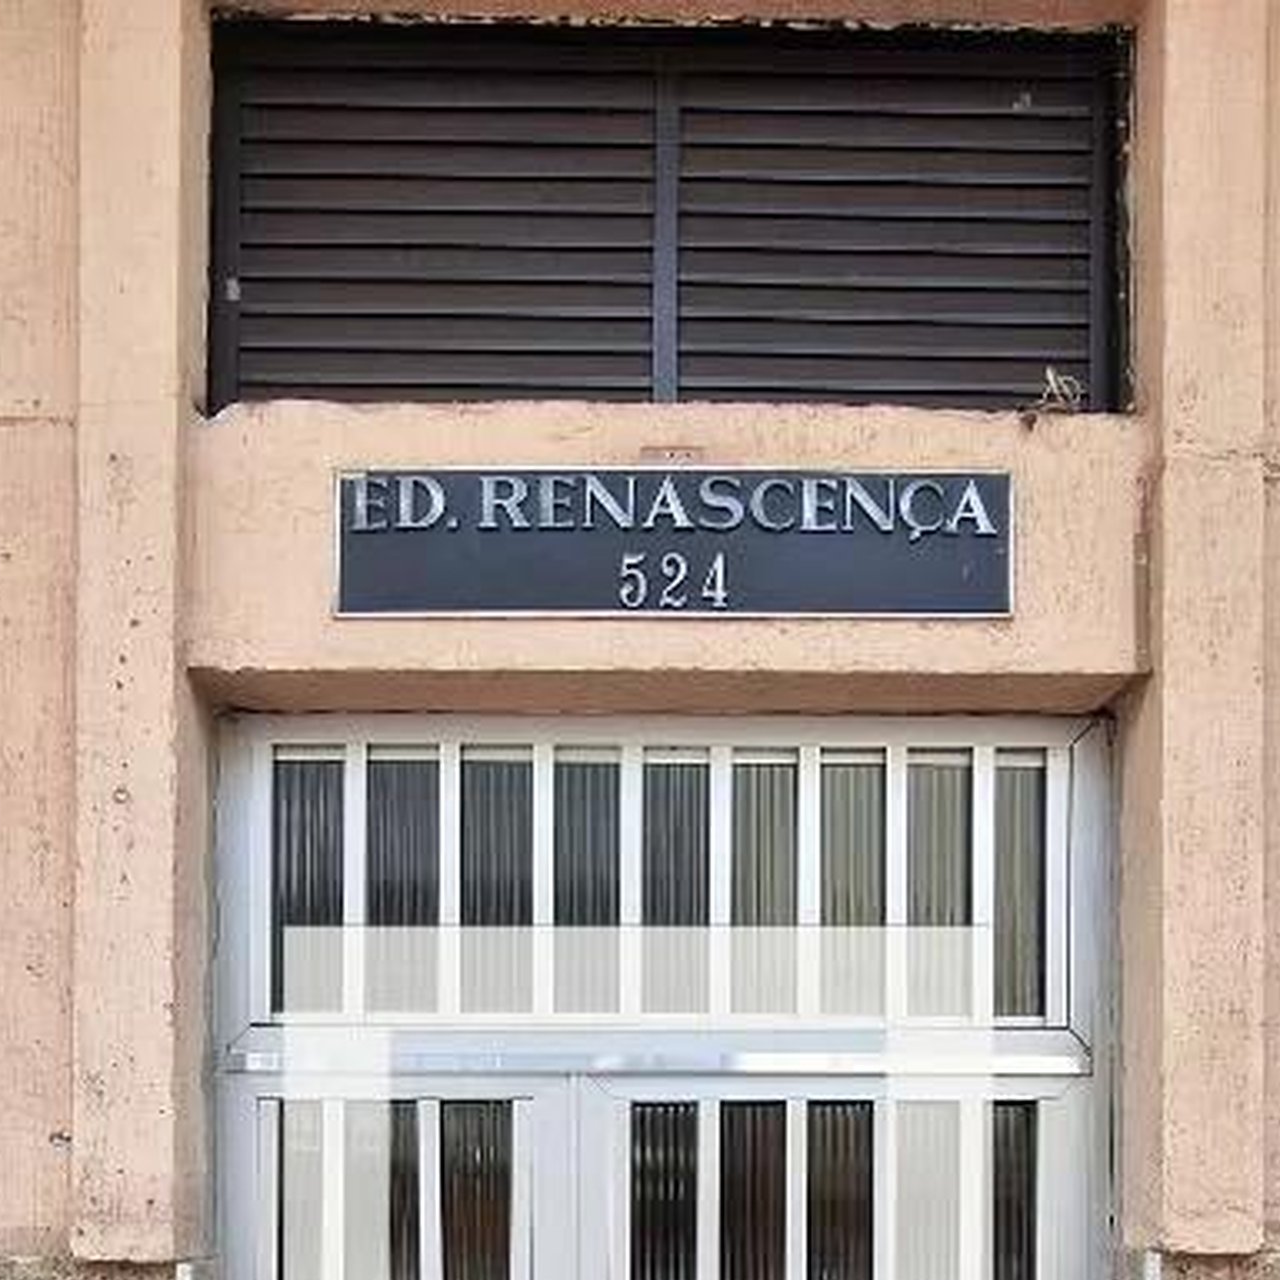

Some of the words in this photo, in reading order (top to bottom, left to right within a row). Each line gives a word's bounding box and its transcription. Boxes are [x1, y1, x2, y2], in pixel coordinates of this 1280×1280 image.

[349, 474, 457, 533] ED.
[476, 473, 999, 541] RENASCENÇA
[619, 552, 729, 609] 524
